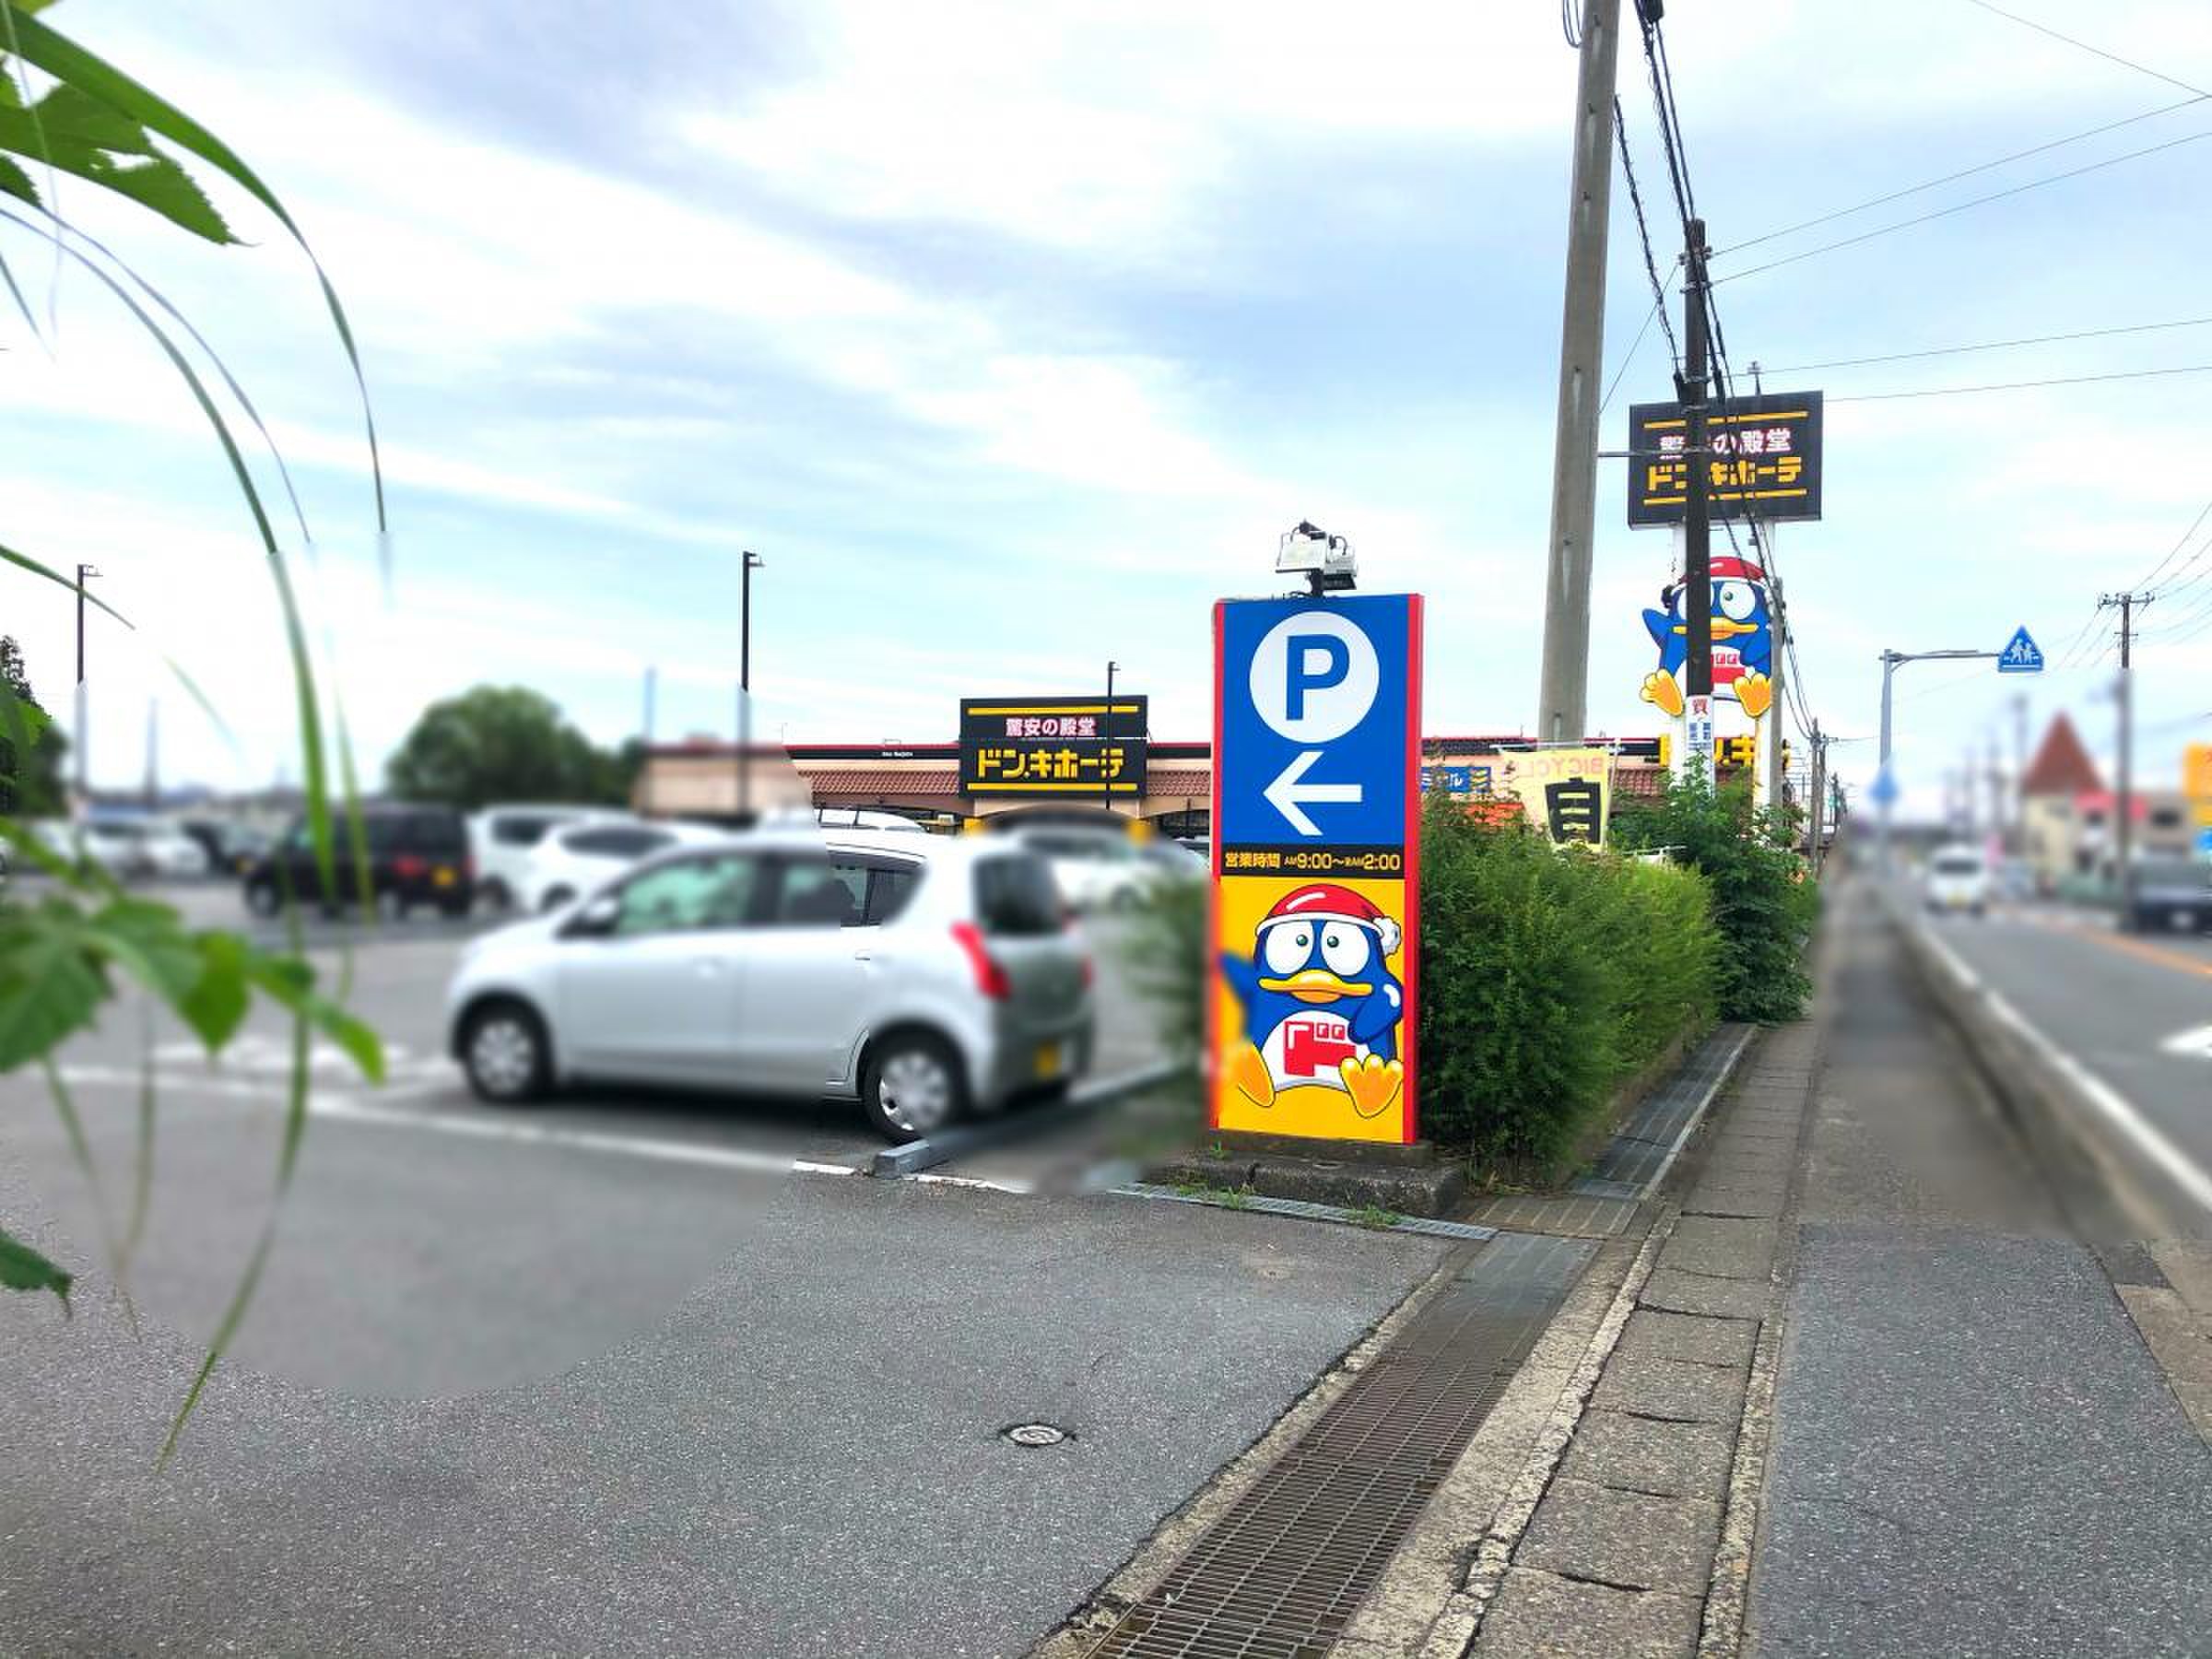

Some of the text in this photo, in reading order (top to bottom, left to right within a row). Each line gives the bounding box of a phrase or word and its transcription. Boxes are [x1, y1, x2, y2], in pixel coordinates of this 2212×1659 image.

[1659, 428, 1791, 459] 驚の殿堂
[1286, 633, 1350, 721] P
[1006, 717, 1096, 737] 驚安の殿堂
[1225, 852, 1281, 868] 営業時間
